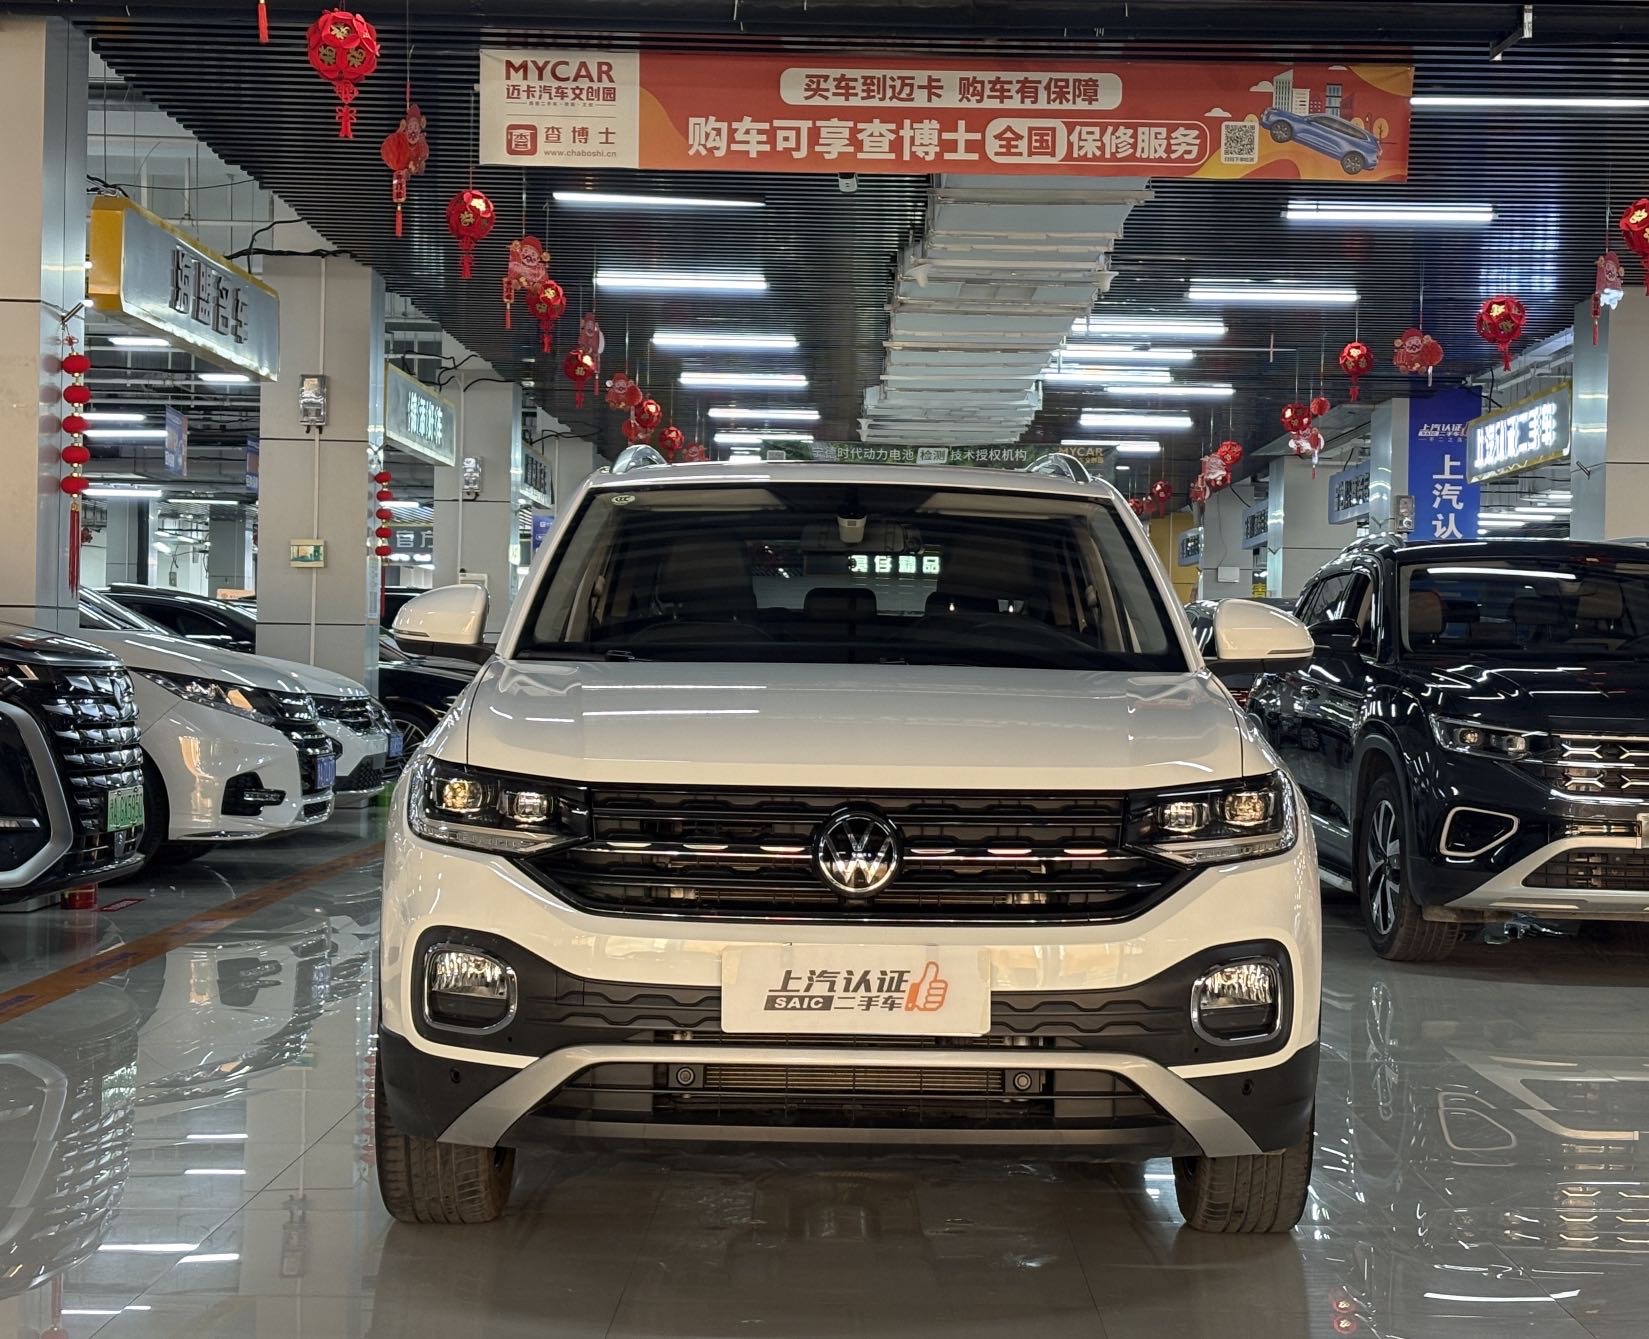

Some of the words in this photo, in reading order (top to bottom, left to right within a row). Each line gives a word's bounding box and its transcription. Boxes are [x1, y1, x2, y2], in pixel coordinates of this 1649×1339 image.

[505, 60, 615, 83] MYCAR
[506, 85, 616, 102] 迈卡汽车文创园
[804, 73, 943, 101] 买车到迈卡
[958, 75, 1099, 106] 购车有保障
[544, 126, 616, 145] 查博士
[544, 150, 617, 158] www.chaboshi.cn
[768, 969, 911, 993] 上汽认证
[774, 997, 824, 1009] SAIC
[834, 995, 904, 1011] 二手车
